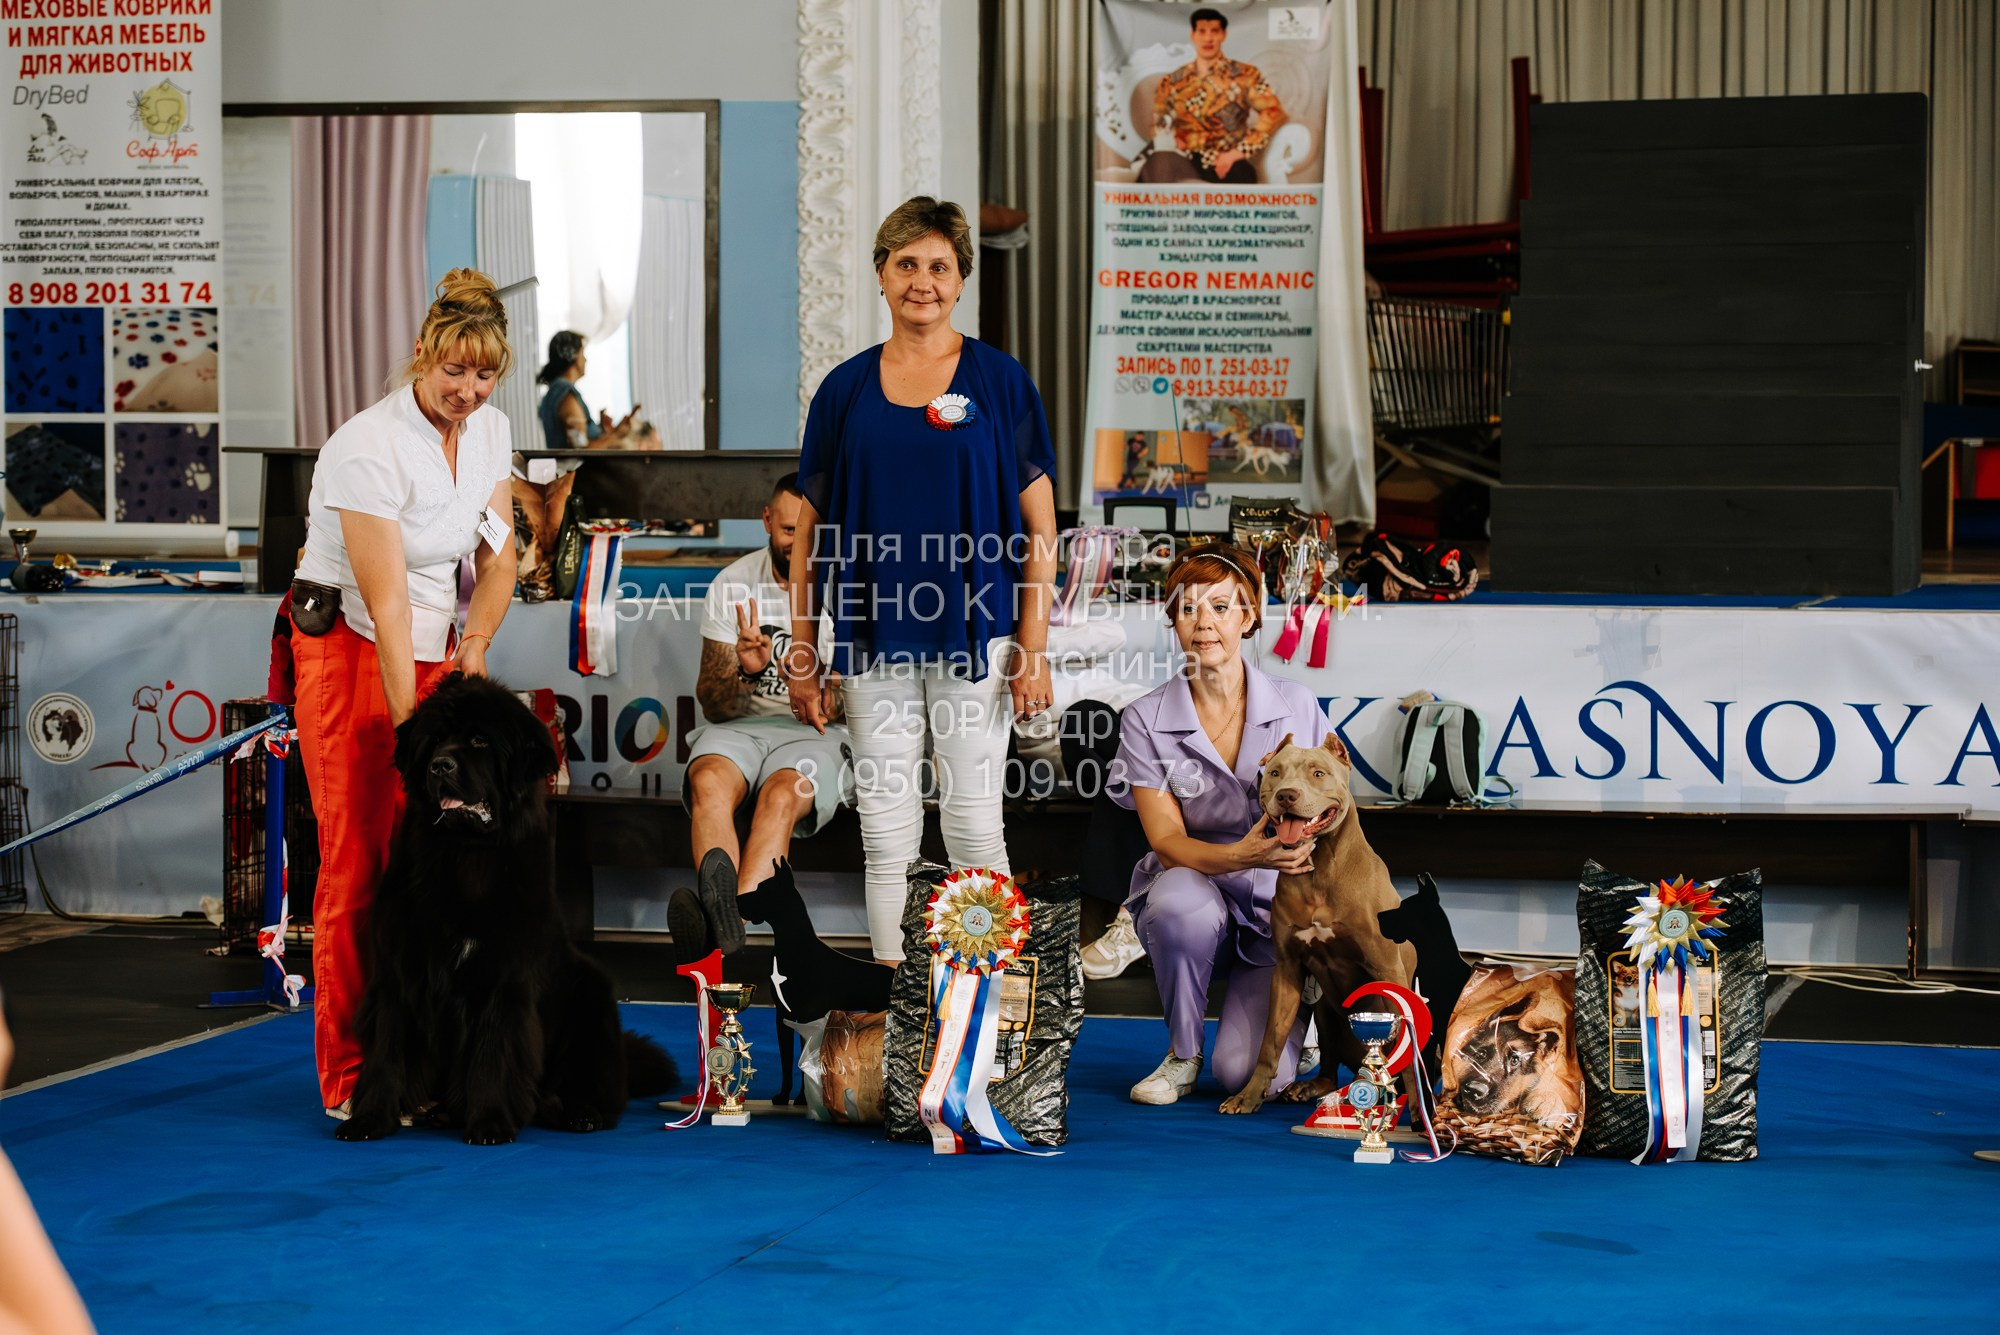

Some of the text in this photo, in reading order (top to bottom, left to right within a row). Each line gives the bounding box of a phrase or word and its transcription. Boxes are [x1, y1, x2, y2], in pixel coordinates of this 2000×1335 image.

[0, 0, 211, 20] МЕХОВЫЕ КОВРИКИ
[8, 23, 206, 47] И МЯГКАЯ МЕБЕЛЬ
[20, 51, 193, 79] ДЛЯ ЖИВОТНЫХ
[12, 84, 90, 110] DryBed
[1104, 192, 1318, 205] УНИКАЛЬНАЯ ВОЗМОЖНОСТЬ
[1194, 209, 1250, 219] МИРОВЫХ
[1113, 238, 1142, 248] ОДИН
[1146, 238, 1160, 247] ИЗ
[1227, 253, 1258, 262] МИРА
[1098, 270, 1315, 289] GREGOR NEMANIC
[8, 283, 24, 304] 8
[30, 283, 78, 304] 908
[85, 283, 131, 303] 201
[140, 282, 171, 303] 31
[180, 282, 212, 303] 74
[1203, 295, 1281, 305] КРАСНОЯРСКЕ
[1120, 311, 1212, 321] МАСТЕР-КЛАССЫ
[1136, 342, 1272, 353] СЕКРЕТАМИ МАСТЕРСТВА
[1116, 357, 1176, 374] ЗАПИСЬ
[1181, 357, 1201, 374] ПО
[1220, 358, 1290, 375] 251-03-17
[1173, 379, 1287, 397] 8-913-534-03-17
[716, 1055, 724, 1068] 1
[1358, 1088, 1369, 1102] 2
